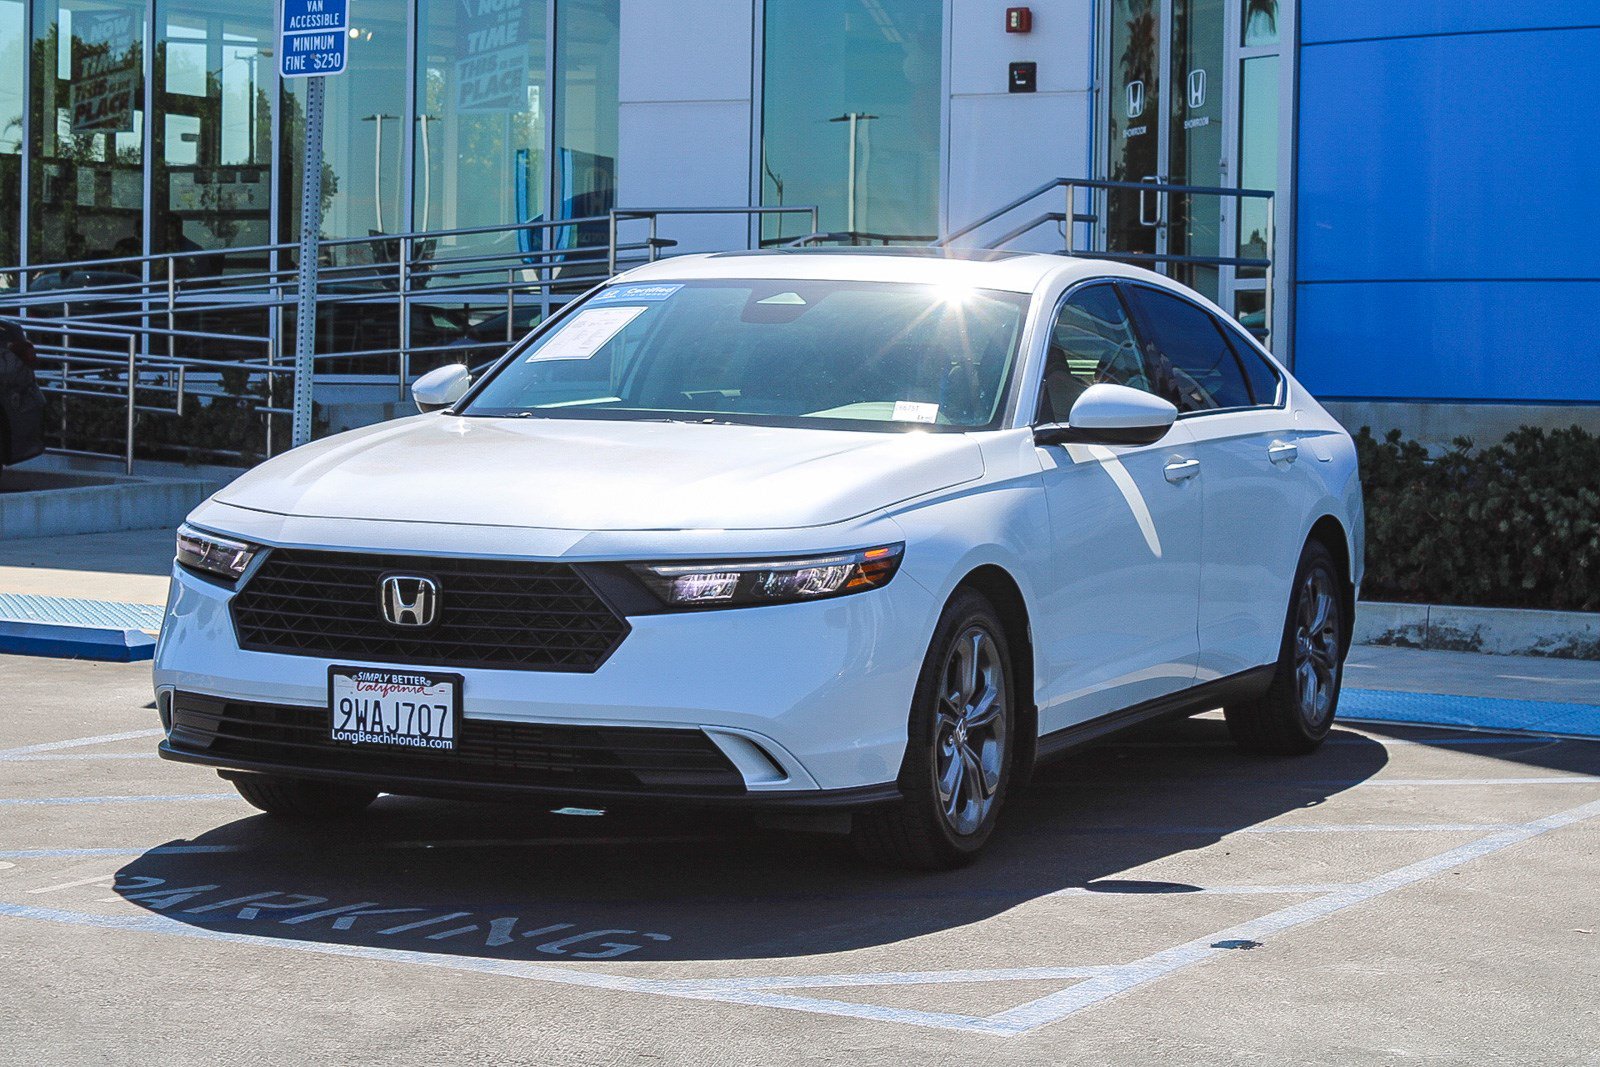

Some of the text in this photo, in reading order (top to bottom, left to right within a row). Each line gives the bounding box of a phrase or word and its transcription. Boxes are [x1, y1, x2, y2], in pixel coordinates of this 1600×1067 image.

[307, 0, 323, 12] VAN
[289, 13, 339, 28] ACCESSIBLE
[293, 35, 335, 52] MINIMUM
[467, 21, 519, 54] TIME
[285, 52, 341, 71] FINE $250
[460, 54, 498, 81] THIS
[459, 67, 523, 105] PLACE
[357, 671, 426, 686] SIMPLY BETTER
[356, 681, 433, 698] California
[339, 697, 448, 738] 9WAJ707
[331, 728, 453, 749] LongBeachHonda.com
